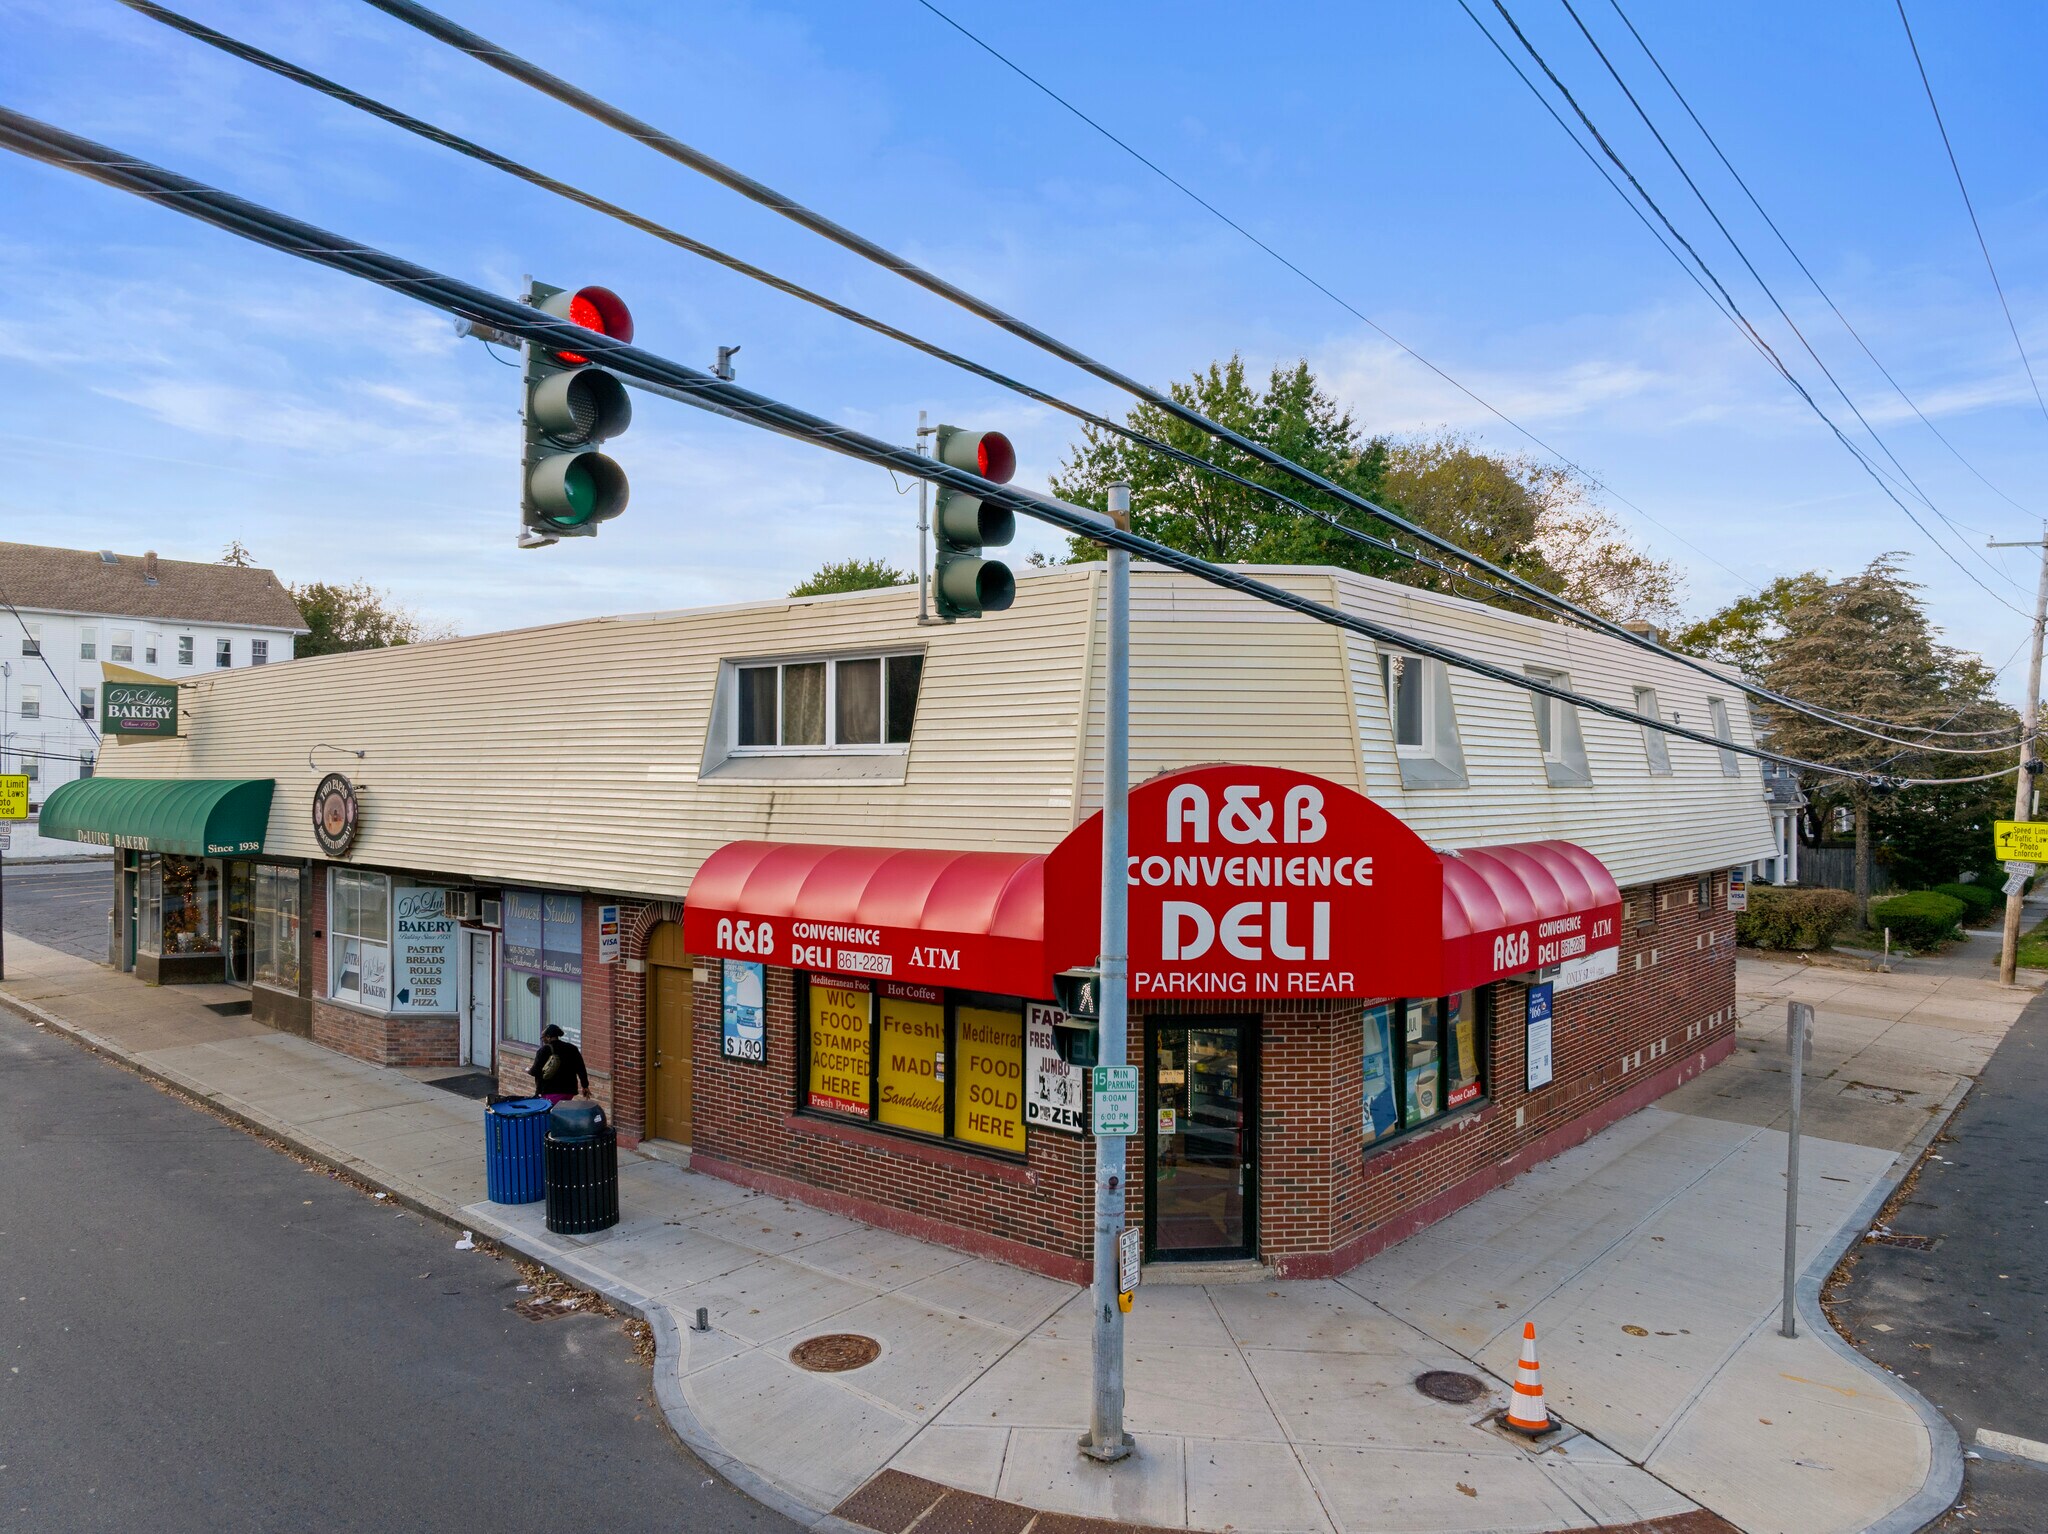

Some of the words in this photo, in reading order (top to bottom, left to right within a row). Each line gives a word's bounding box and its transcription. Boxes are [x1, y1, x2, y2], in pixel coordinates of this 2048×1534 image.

[108, 705, 173, 718] BAKERY
[6, 780, 25, 788] Limit
[320, 781, 332, 800] TWO
[332, 779, 348, 799] PAPAS
[7, 790, 25, 798] Laws
[1166, 783, 1328, 845] A&B
[77, 829, 110, 846] DeLUISE
[114, 834, 149, 851] BAKERY
[2013, 826, 2032, 835] Speed
[2014, 835, 2032, 843] Traffic
[208, 844, 234, 853] Since
[239, 842, 260, 851] 1938
[2013, 850, 2042, 858] Enforced
[2019, 843, 2039, 851] Photo
[1127, 855, 1373, 887] CONVENIENCE
[399, 891, 445, 919] DeLui
[543, 897, 576, 924] Studio
[398, 920, 454, 932] BAKERY
[792, 922, 881, 946] CONVENIENCE
[1161, 900, 1331, 961] DELI
[1538, 915, 1582, 938] CONVENIENCE
[1591, 918, 1612, 939] ATM
[602, 938, 618, 946] VISA
[716, 917, 775, 955] A&B
[407, 946, 445, 954] PASTRY
[791, 943, 832, 969] DELI
[838, 953, 891, 973] 861-2287
[908, 946, 961, 971] ATM
[1493, 930, 1530, 972] A&B
[1538, 940, 1559, 965] DELI
[406, 956, 445, 965] BREADS
[409, 967, 442, 975] ROLLS
[410, 977, 442, 985] CAKES
[810, 974, 854, 989] Mediterranean
[1135, 972, 1246, 993] PARKING
[1256, 973, 1279, 993] IN
[1287, 973, 1355, 993] REAR
[363, 983, 387, 999] BAKERY
[415, 988, 437, 996] PIES
[827, 990, 856, 1009] WIC
[887, 983, 905, 996] Hot
[906, 986, 936, 1000] Coffee
[412, 998, 439, 1007] PIZZA
[820, 1011, 863, 1032] FOOD
[1031, 1007, 1071, 1026] FAR
[813, 1032, 870, 1056] STAMPS
[813, 1051, 870, 1077] ACCEPTED
[892, 1055, 936, 1077] MAD
[970, 1055, 1020, 1079] FOOD
[1040, 1057, 1070, 1076] JUMBO
[821, 1075, 861, 1098] HERE
[1094, 1072, 1107, 1086] 15
[1113, 1070, 1129, 1079] MIN
[1108, 1080, 1135, 1089] PARKING
[811, 1095, 834, 1110] Fresh
[835, 1099, 869, 1116] Produce
[969, 1084, 1018, 1110] SOLD
[1448, 1091, 1463, 1106] Phone
[1463, 1086, 1477, 1099] Cards
[1101, 1113, 1116, 1121] 6:00
[1111, 1104, 1119, 1112] TO
[968, 1111, 1015, 1139] HERE
